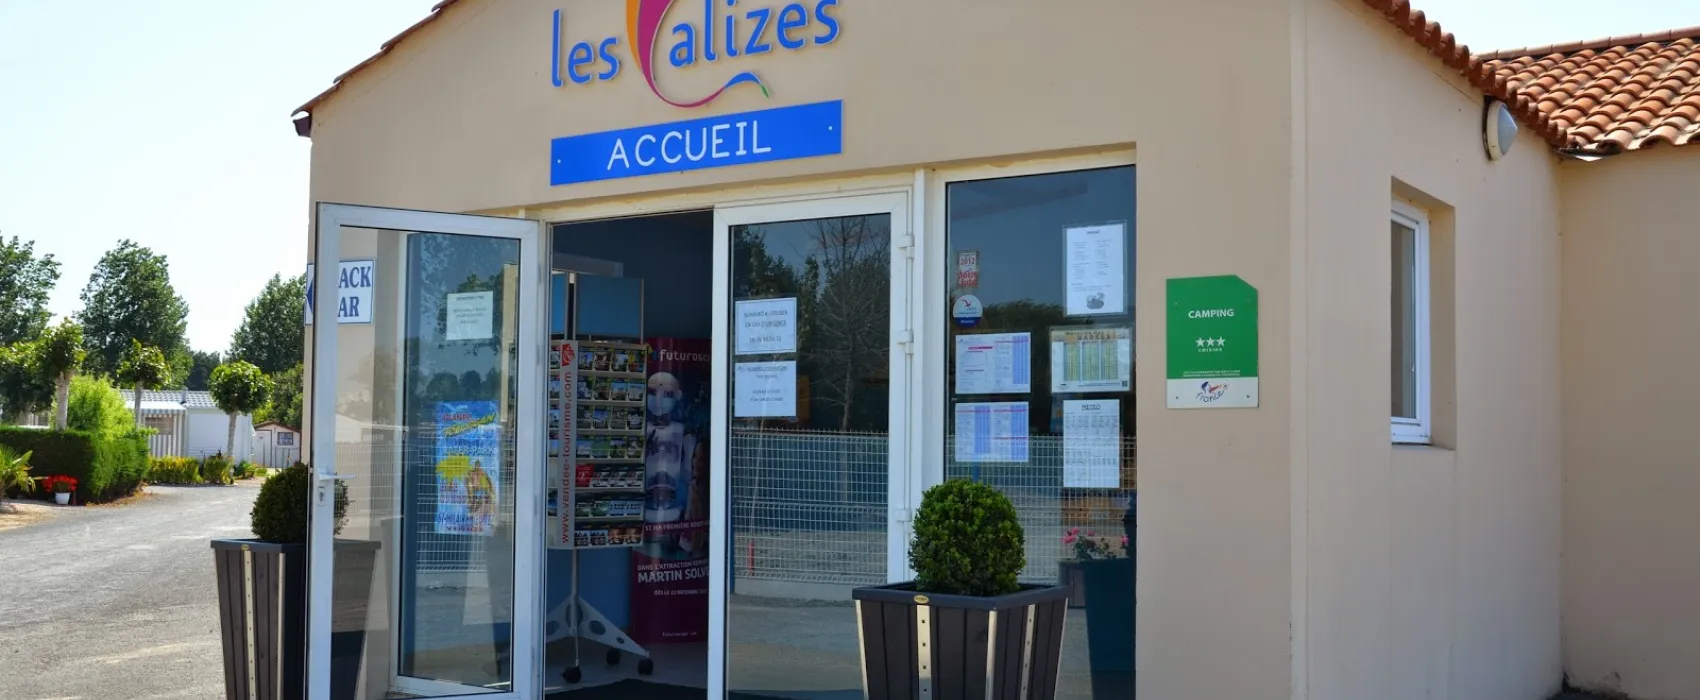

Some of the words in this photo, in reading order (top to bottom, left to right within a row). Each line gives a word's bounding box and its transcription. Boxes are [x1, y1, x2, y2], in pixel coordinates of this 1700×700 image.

[552, 9, 623, 88] les
[607, 120, 772, 171] ACCUEIL
[338, 266, 372, 289] ACK
[338, 296, 360, 318] AR
[1188, 308, 1234, 319] CAMPING
[562, 371, 572, 544] www.vendee-tourisme.com
[638, 569, 683, 583] MARTIN
